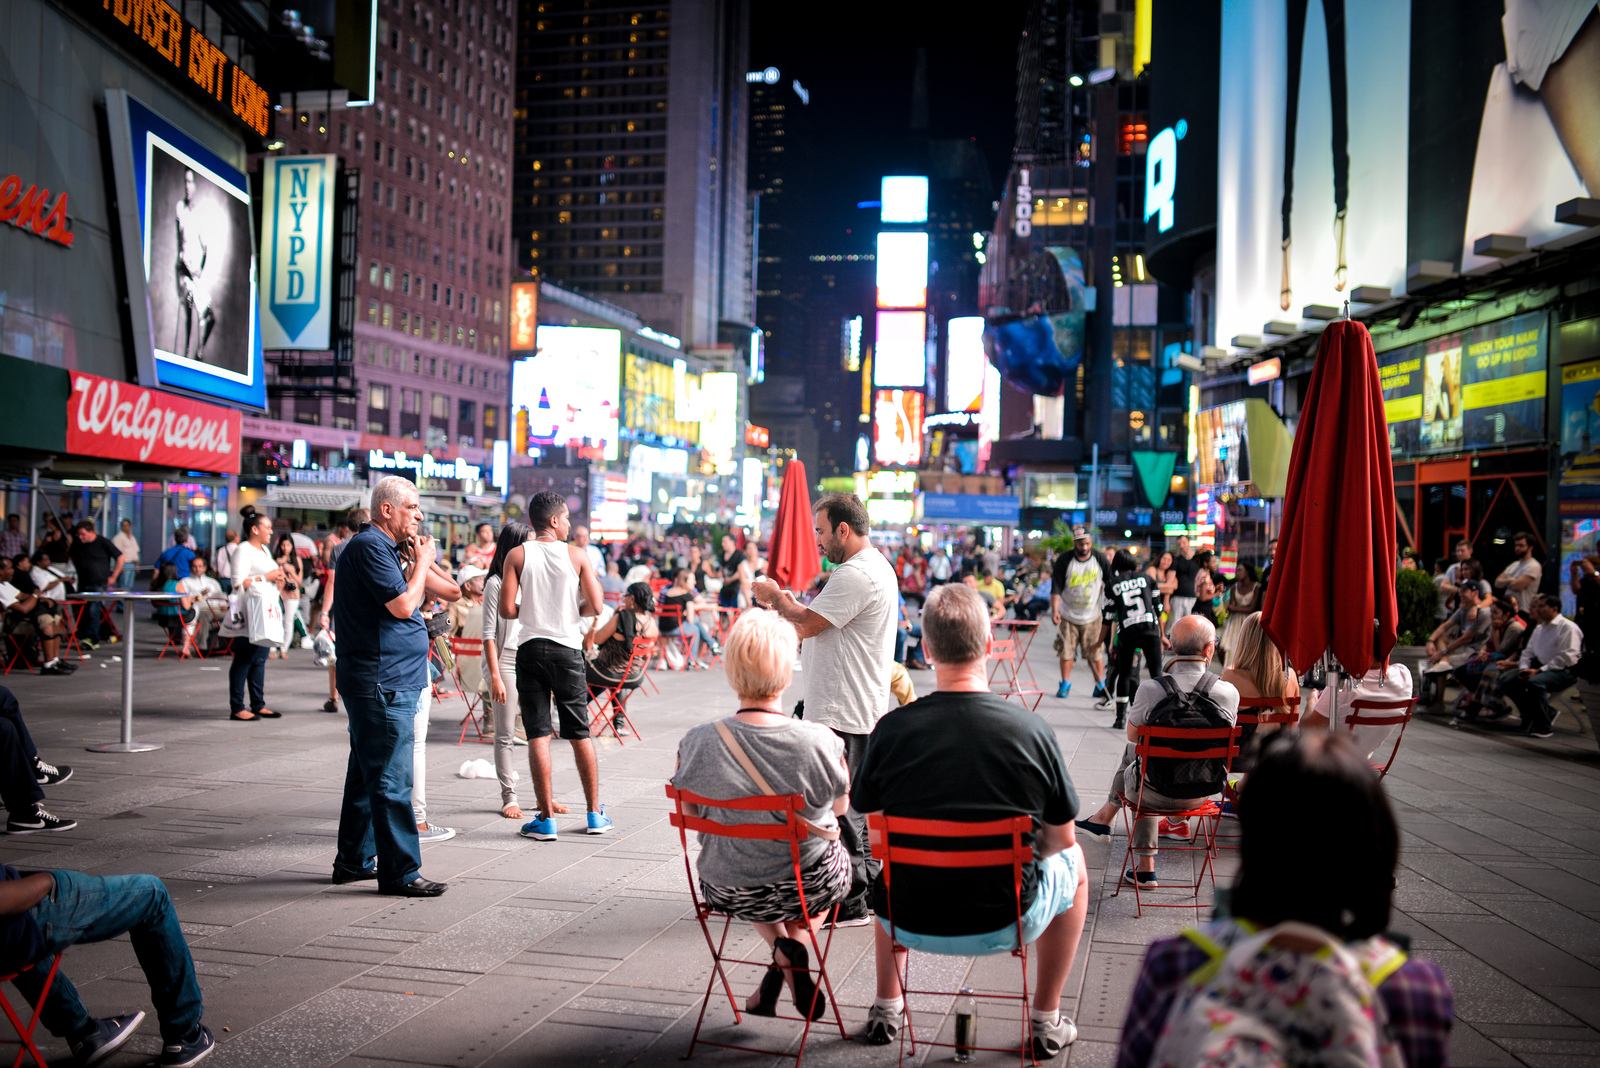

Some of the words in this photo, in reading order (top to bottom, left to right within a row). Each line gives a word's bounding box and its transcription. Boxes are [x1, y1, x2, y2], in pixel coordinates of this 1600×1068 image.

[103, 0, 183, 68] VISER
[232, 64, 270, 137] USING
[0, 175, 75, 246] ens
[287, 168, 310, 300] NYPD
[1015, 169, 1032, 237] 1500
[75, 376, 232, 462] Walgreens
[1121, 588, 1148, 619] 5
